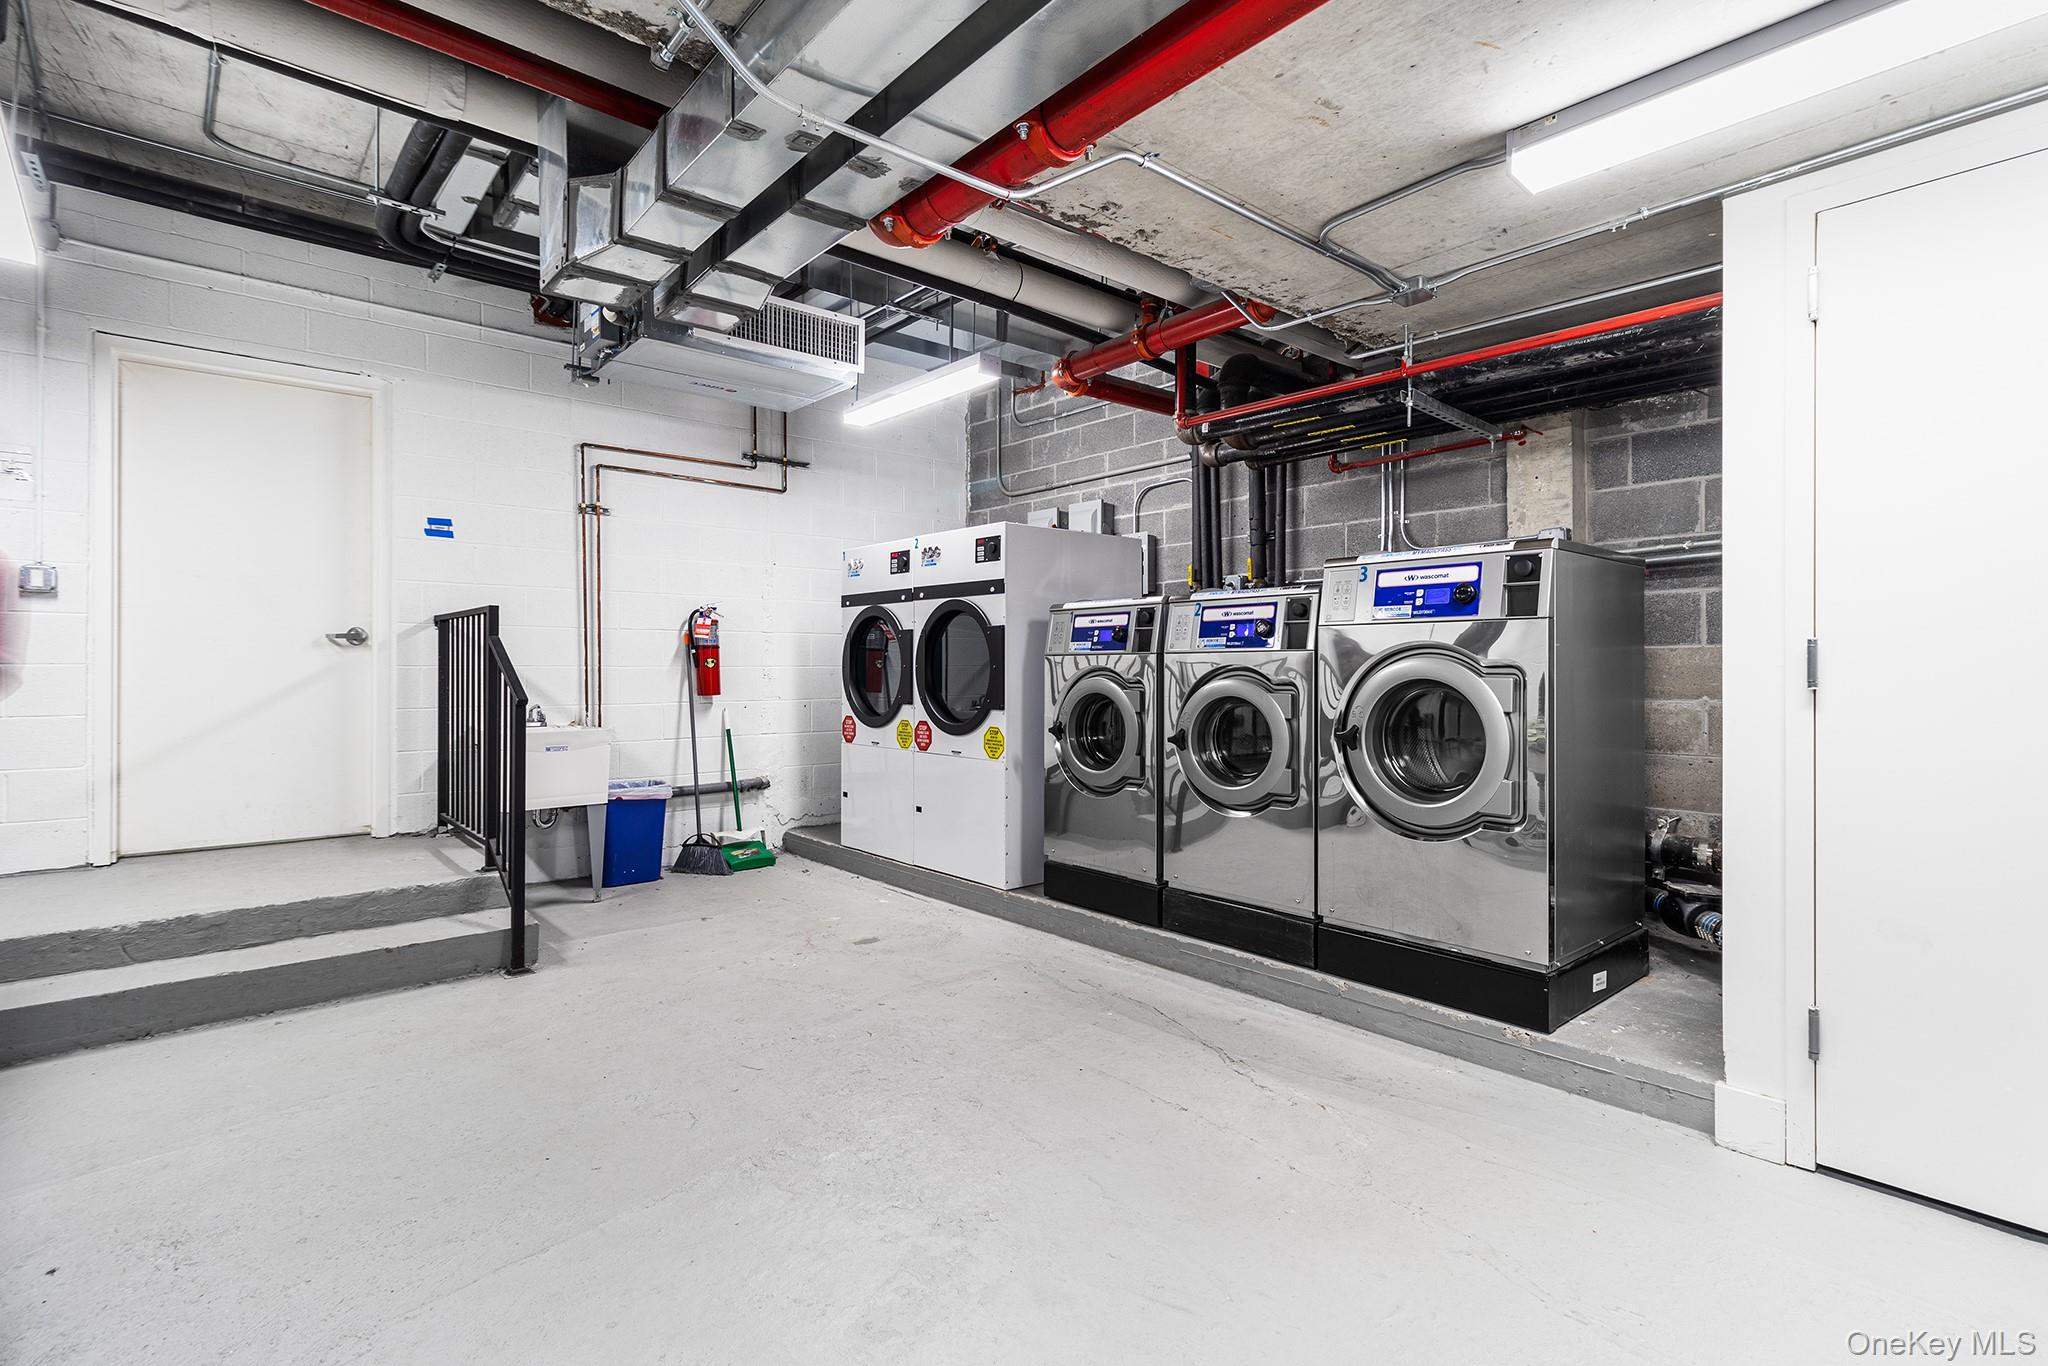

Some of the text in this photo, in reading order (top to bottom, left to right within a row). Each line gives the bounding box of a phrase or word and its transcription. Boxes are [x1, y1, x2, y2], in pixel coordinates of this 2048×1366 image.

[914, 538, 919, 549] 2
[1359, 566, 1368, 582] 3
[1194, 602, 1201, 617] 2
